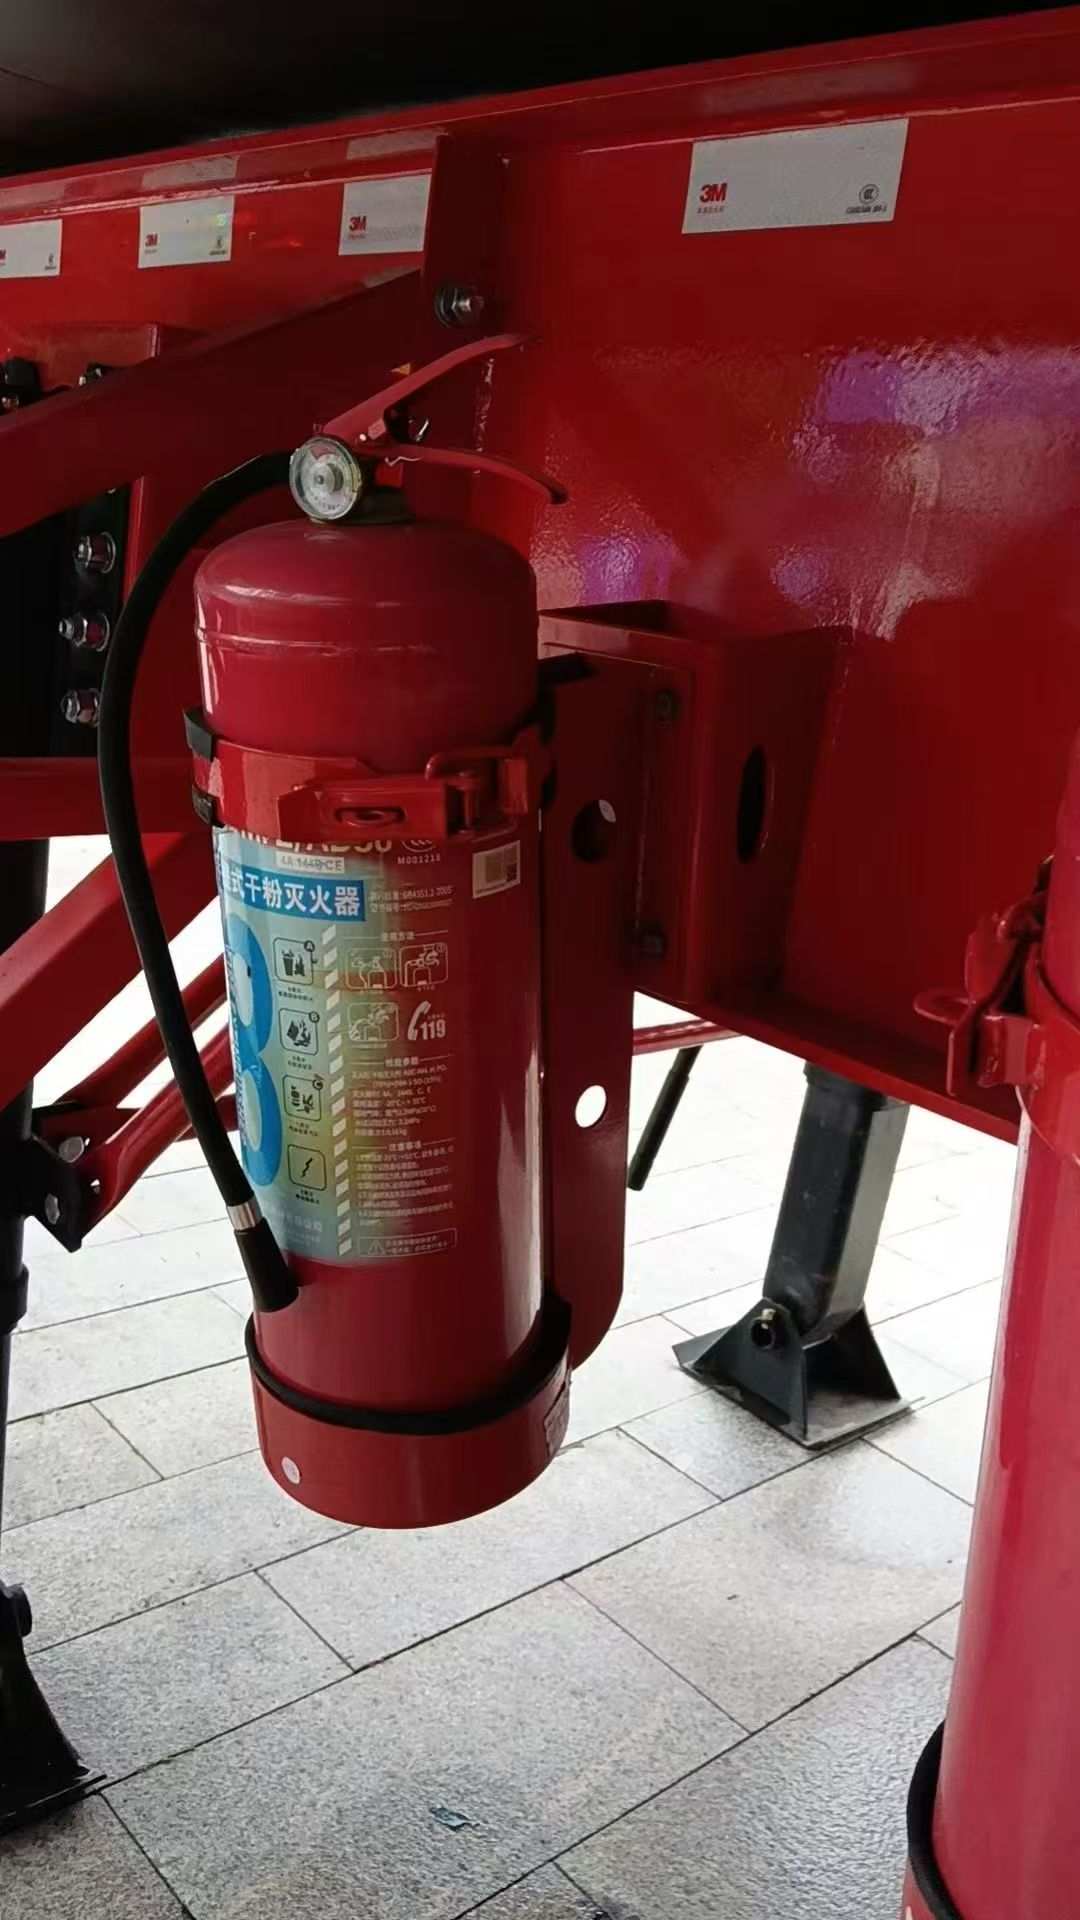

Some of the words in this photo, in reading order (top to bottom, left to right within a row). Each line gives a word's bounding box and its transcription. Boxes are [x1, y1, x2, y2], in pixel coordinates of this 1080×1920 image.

[700, 182, 728, 204] 3M
[348, 215, 368, 232] 3M
[420, 1019, 446, 1041] 119
